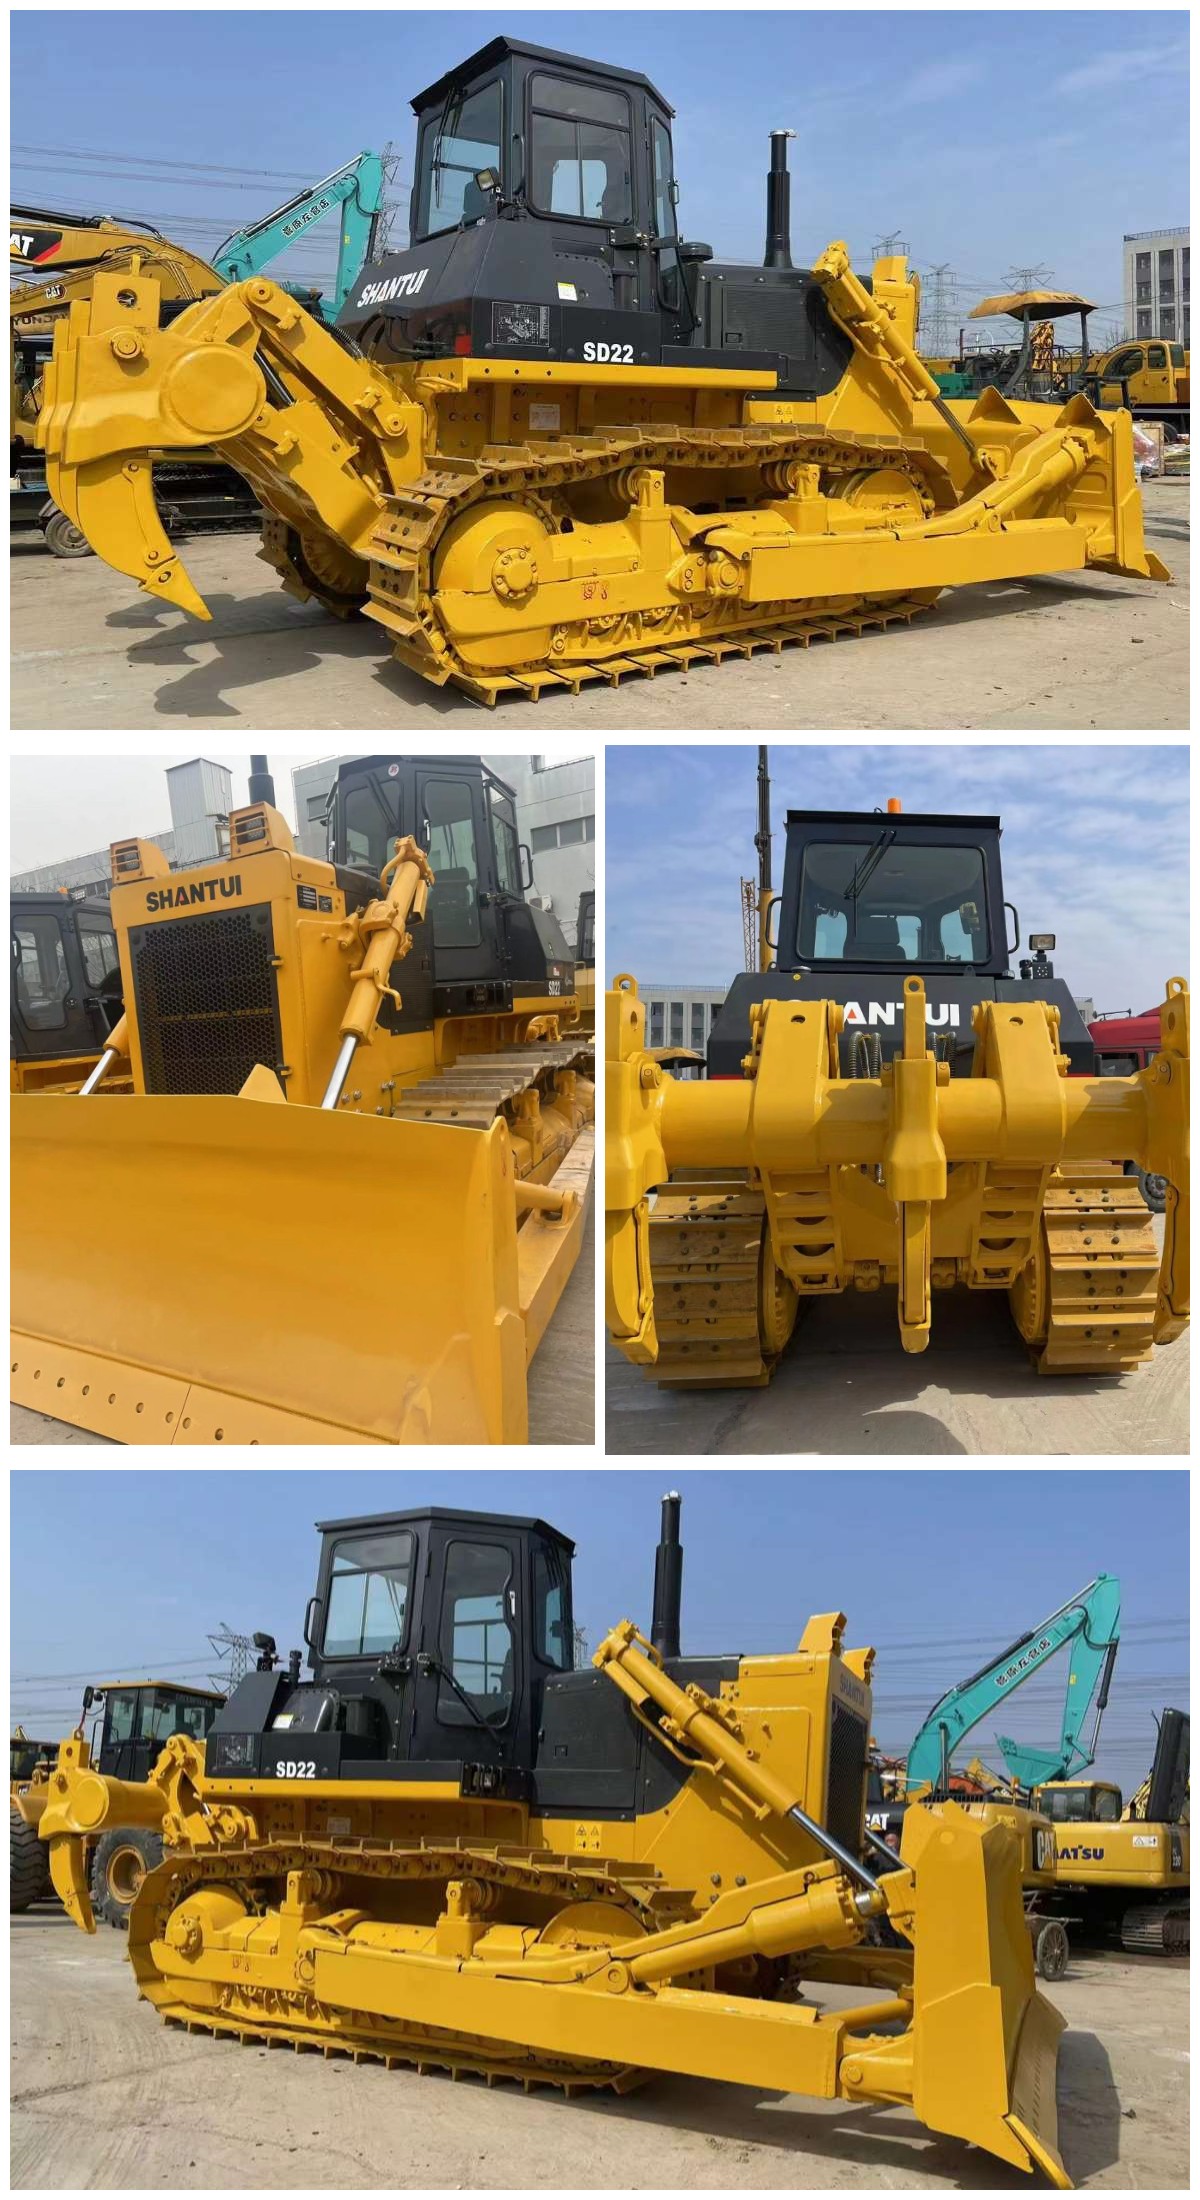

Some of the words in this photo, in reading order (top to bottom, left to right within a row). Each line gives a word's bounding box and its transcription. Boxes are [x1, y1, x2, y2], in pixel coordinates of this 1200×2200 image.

[46, 285, 61, 299] CAT
[357, 268, 430, 308] SHANTUI
[583, 342, 634, 363] SD22
[146, 875, 242, 912] SHANTUI
[276, 1761, 316, 1778] SD22
[1056, 1844, 1105, 1860] ATSU
